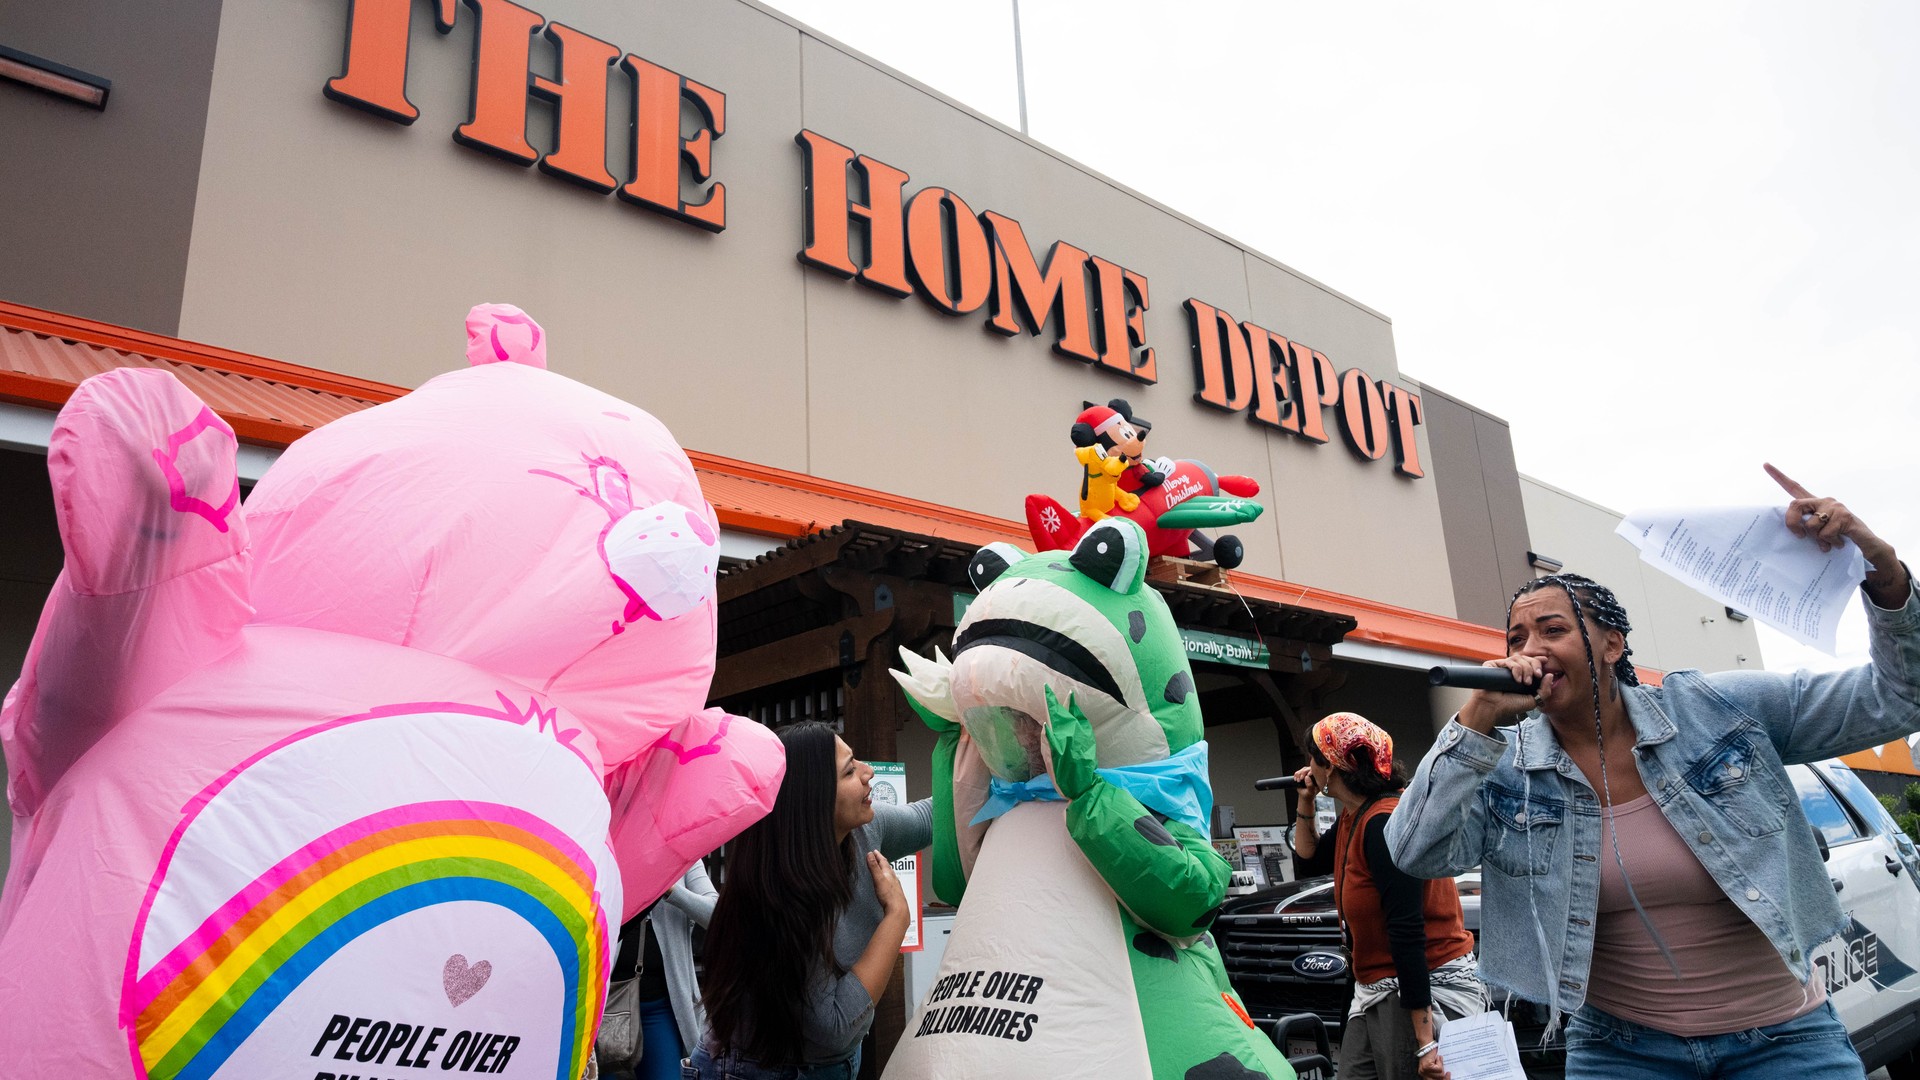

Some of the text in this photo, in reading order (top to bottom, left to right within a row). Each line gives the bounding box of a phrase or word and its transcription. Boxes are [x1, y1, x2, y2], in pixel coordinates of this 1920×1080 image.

[322, 0, 1425, 480] THE HOME DEPOT
[1162, 474, 1190, 493] Merry
[1165, 481, 1204, 510] Christmas
[1182, 635, 1256, 660] ionally Built.
[1282, 916, 1323, 924] SETINA
[1301, 956, 1334, 971] Ford
[926, 970, 1044, 1006] PEOPLE OVER
[914, 1005, 1039, 1043] BILLIONAIRES
[310, 1014, 521, 1074] PEOPLE OVER
